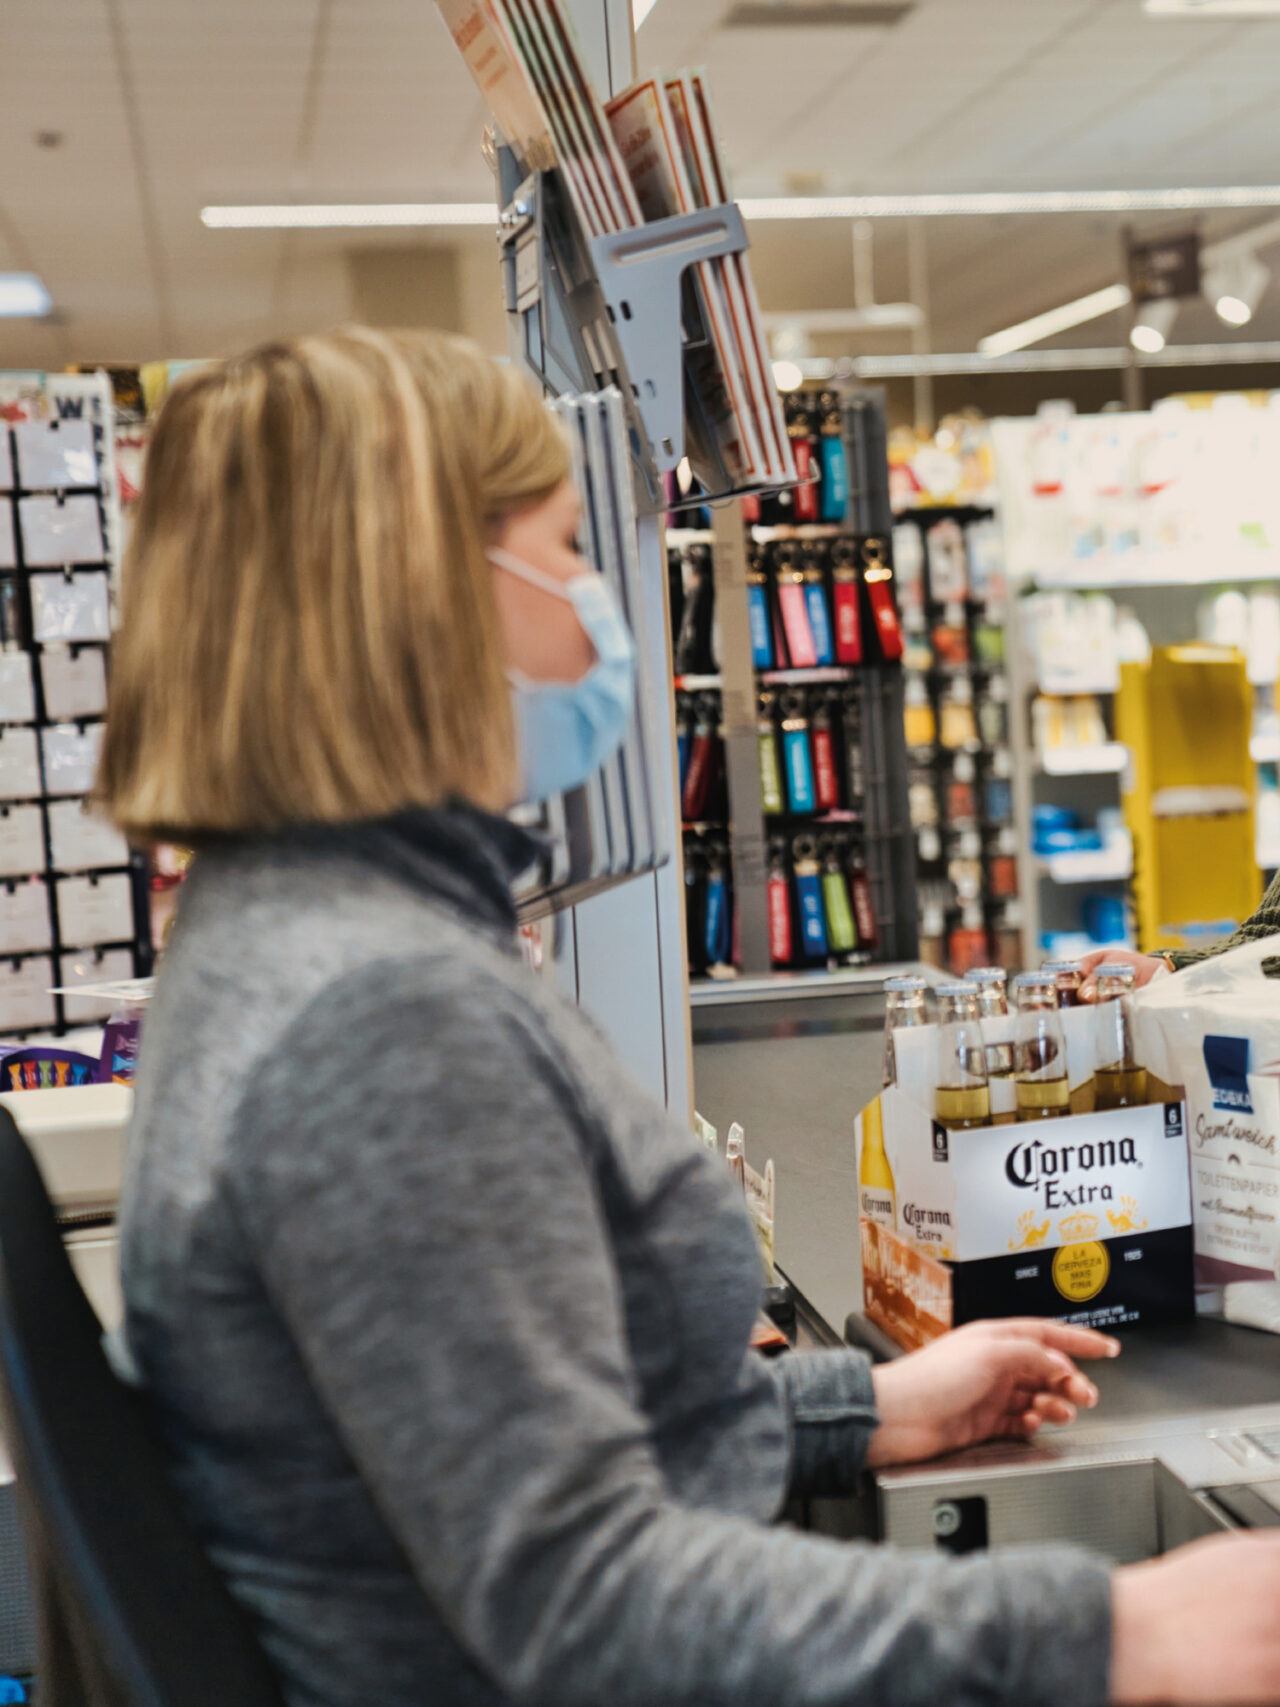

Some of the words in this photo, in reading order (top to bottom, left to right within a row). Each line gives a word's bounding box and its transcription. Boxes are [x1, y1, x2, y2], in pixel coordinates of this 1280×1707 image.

[1168, 1108, 1177, 1124] 6
[1005, 1137, 1137, 1192] Corona
[861, 1193, 892, 1216] Corona
[1045, 1180, 1113, 1209] Extra
[902, 1202, 952, 1228] Corona
[915, 1224, 942, 1242] Extra
[1059, 1257, 1102, 1273] CERVEZA
